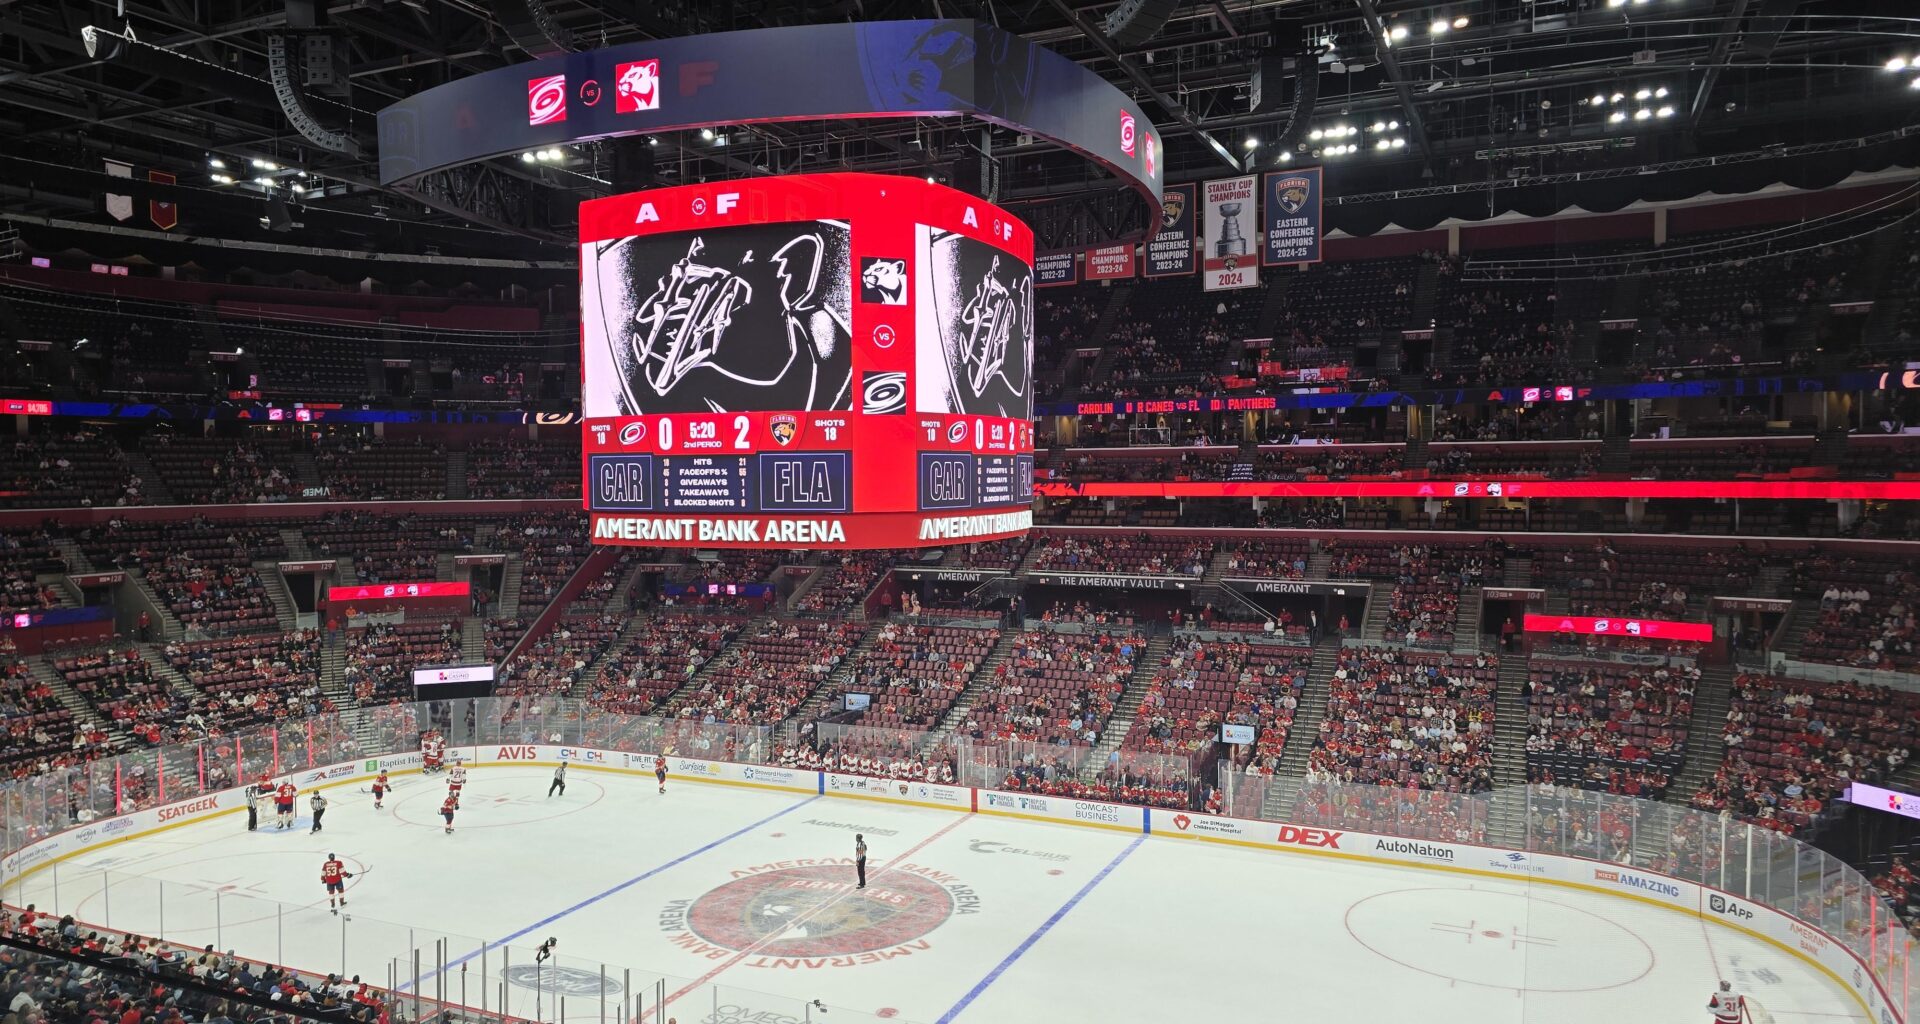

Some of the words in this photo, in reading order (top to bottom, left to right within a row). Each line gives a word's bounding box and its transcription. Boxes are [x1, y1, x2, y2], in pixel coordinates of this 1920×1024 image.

[1207, 182, 1236, 194] STANLEY
[1237, 179, 1253, 190] CUP
[1209, 190, 1251, 203] CHAMPIONS
[635, 202, 660, 224] A
[716, 192, 740, 215] F
[962, 206, 978, 229] A
[1003, 221, 1013, 241] F
[1276, 217, 1309, 228] EASTERN
[1155, 230, 1184, 241] EASTERN
[1270, 226, 1315, 238] CONFERENCE
[1150, 239, 1190, 251] CONFERENCE
[1271, 237, 1314, 249] CHAMPIONS
[1150, 250, 1189, 261] CHAMPIONS
[1277, 247, 1307, 258] 2024-25
[1091, 253, 1128, 265] CHAMPIONS
[1156, 259, 1183, 270] 2023-24
[1036, 260, 1071, 271] CHAMPIONS
[1096, 264, 1123, 274] 2023-24
[1041, 269, 1066, 280] 2022-23
[1218, 274, 1243, 287] 2024
[878, 332, 890, 341] VS
[1077, 402, 1113, 414] CAROLIN
[1145, 401, 1174, 412] CANES
[1228, 397, 1276, 410] PANTHERS
[591, 424, 611, 432] SHOTS
[815, 419, 846, 427] SHOTS
[920, 420, 941, 428] SHOTS
[658, 417, 673, 450] 0
[689, 421, 716, 439] 5:20
[734, 415, 750, 449] 2
[824, 427, 837, 441] 18
[975, 418, 984, 450] 0
[1008, 421, 1015, 450] 2
[683, 440, 697, 448] 2nd
[696, 440, 722, 448] PERIOD
[693, 458, 713, 466] HITS
[679, 468, 720, 476] FACEOFFS
[600, 463, 643, 502] CAR
[680, 478, 728, 486] GIVEAWAYS
[774, 461, 832, 503] FLA
[930, 460, 965, 501] CAR
[678, 488, 730, 497] TAKEAWAYS
[674, 498, 707, 506] BLOCKED
[708, 499, 735, 507] SHOTS
[594, 517, 696, 541] AMERANT
[699, 519, 760, 542] BANK
[763, 520, 846, 543] ARENA
[919, 516, 995, 540] AMERANT
[996, 512, 1017, 533] BANK
[281, 564, 293, 572] 128
[937, 572, 981, 582] AMERANT
[1059, 576, 1076, 586] THE
[1078, 577, 1126, 587] AMERANT
[1129, 578, 1165, 589] VAULT
[1255, 582, 1312, 594] AMERANT
[1722, 600, 1738, 609] 104
[497, 746, 536, 760] AVIS
[560, 748, 577, 758] CH
[587, 751, 603, 760] CH
[328, 764, 355, 774] ACTION
[379, 759, 405, 769] Baptist
[679, 759, 707, 772] Surfside
[755, 768, 776, 777] Broward
[776, 770, 792, 778] Health
[283, 788, 292, 797] 31
[157, 795, 219, 823] SEATGEEK
[1075, 802, 1118, 814] COMCAST
[1075, 810, 1119, 822] BUSINESS
[802, 818, 899, 837] AutoNation
[1193, 824, 1219, 832] Children's
[1210, 820, 1234, 828] DiMaggio
[1277, 825, 1344, 850] DEX
[1001, 845, 1072, 862] CELSIUS
[1375, 839, 1454, 860] AutoNation
[326, 866, 337, 876] 53
[729, 857, 884, 879] AMERANT
[903, 862, 961, 884] BANK
[947, 884, 980, 916] ARENA
[790, 879, 904, 903] PANTERS
[1620, 874, 1680, 898] AMAZING
[658, 898, 693, 932] ARENA
[1789, 922, 1829, 950] AMERANT
[665, 931, 733, 961] BANK
[744, 938, 931, 969] AMERANT
[1724, 1001, 1737, 1012] 31
